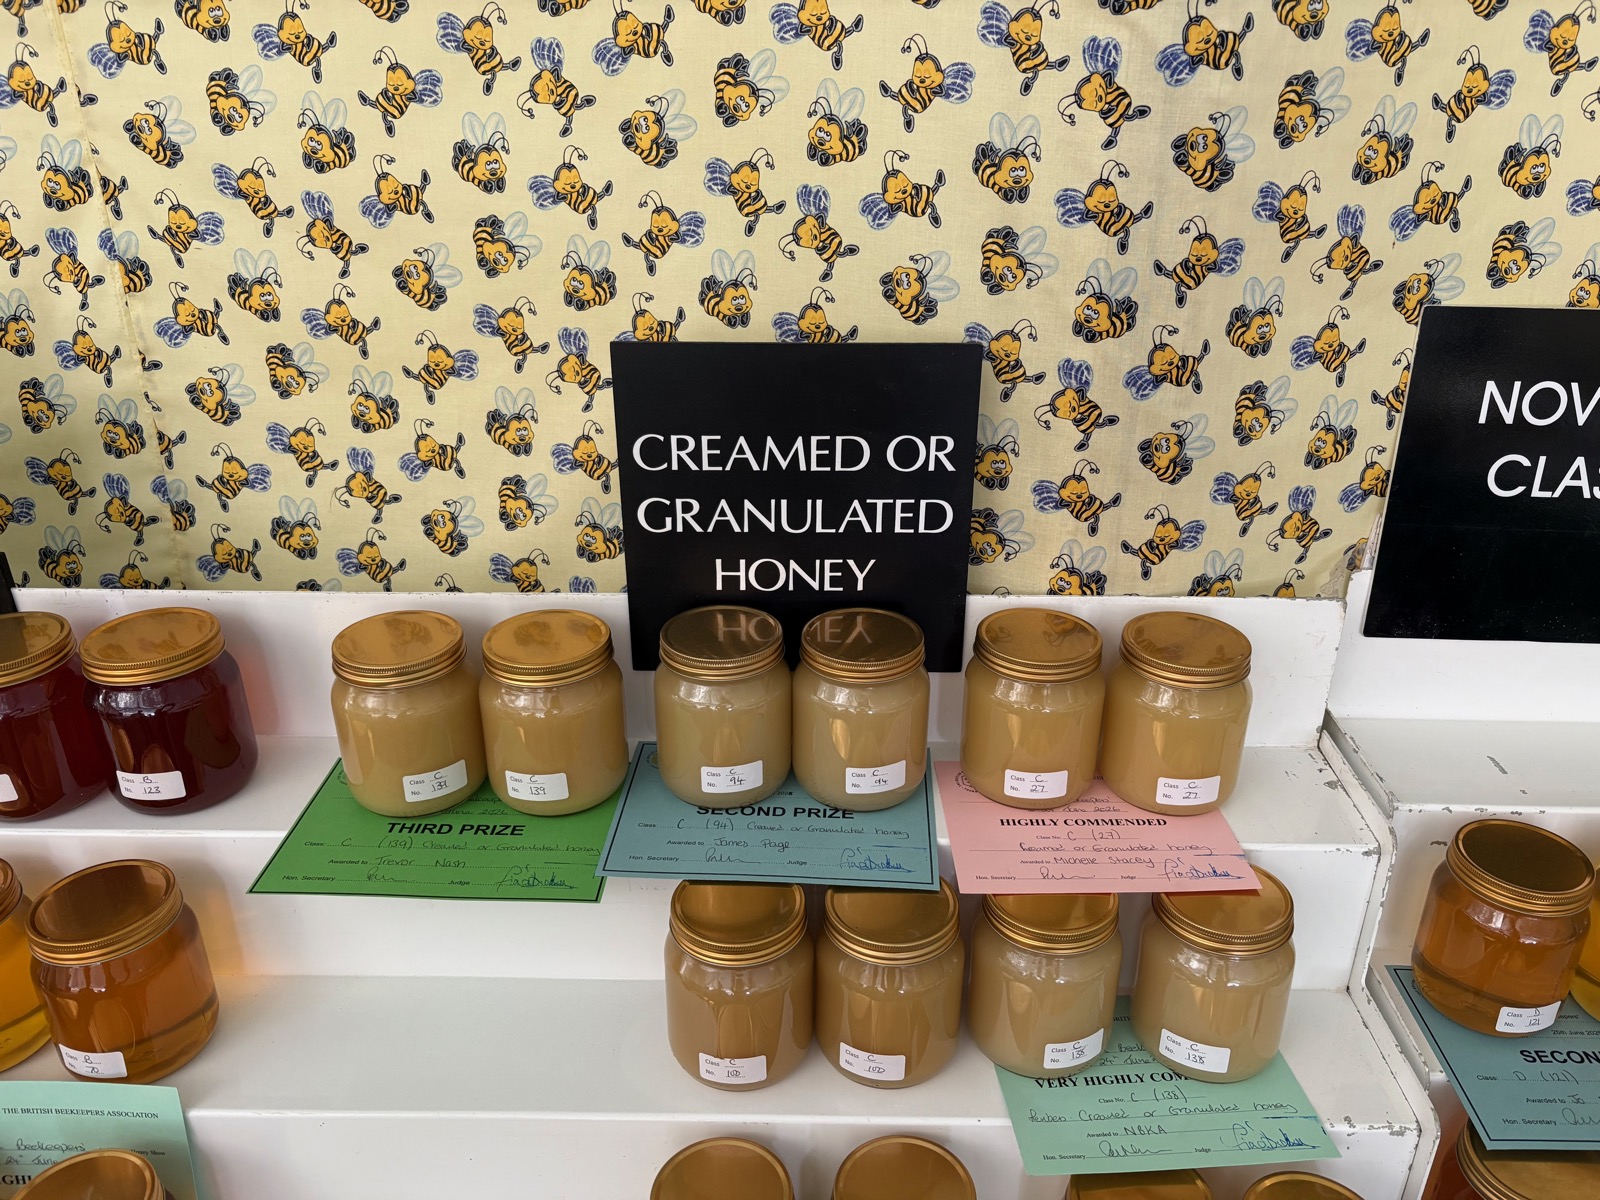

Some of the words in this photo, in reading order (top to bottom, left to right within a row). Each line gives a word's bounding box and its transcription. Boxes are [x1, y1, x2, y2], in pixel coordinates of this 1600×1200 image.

[1478, 380, 1600, 426] NOV
[632, 434, 871, 471] CREAMED
[886, 435, 956, 472] OR
[636, 497, 954, 534] GRANULATED
[715, 558, 876, 591] HONEY
[410, 778, 425, 786] Class
[434, 772, 443, 780] C
[872, 769, 880, 777] C
[1010, 774, 1025, 782] Class
[1034, 774, 1044, 782] C
[122, 776, 135, 784] Class
[142, 776, 153, 784] B
[432, 780, 448, 792] 139
[730, 776, 746, 785] 94
[143, 786, 161, 794] 123
[530, 786, 546, 795] 139
[1030, 785, 1045, 793] 27
[696, 806, 786, 817] SECOND
[794, 807, 854, 819] PRIZE
[677, 818, 685, 829] C
[706, 818, 733, 832] (94)
[1000, 818, 1059, 826] HIGHLY
[1064, 818, 1167, 826] COMMENDED
[387, 823, 453, 835] THIRD
[459, 824, 526, 836] PRIZE
[1067, 830, 1076, 841] C
[1092, 829, 1120, 841] (27)
[342, 838, 352, 847] C
[378, 836, 413, 851] (139)
[714, 838, 749, 847] James
[761, 839, 790, 852] Page
[376, 855, 415, 866] Trevor
[434, 859, 466, 868] Nash
[1054, 857, 1097, 865] Michelle
[1108, 857, 1155, 868] Stacey
[1529, 1018, 1540, 1026] 121
[1073, 1042, 1082, 1050] C
[1166, 1036, 1181, 1047] Class
[846, 1049, 860, 1059] Class
[867, 1054, 875, 1062] C
[1165, 1046, 1175, 1054] No.
[704, 1059, 720, 1067] Class
[1520, 1050, 1600, 1064] SECON
[845, 1060, 855, 1068] No.
[1034, 1077, 1078, 1088] VERY
[1084, 1074, 1145, 1087] HIGHLY
[1512, 1070, 1526, 1081] D
[1540, 1070, 1579, 1084] (121)
[1130, 1093, 1138, 1102] C
[1154, 1085, 1188, 1103] (138)
[55, 1108, 105, 1117] BEEKEEPERS
[106, 1110, 159, 1119] ASSOCIATION
[1124, 1125, 1167, 1136] NBKA
